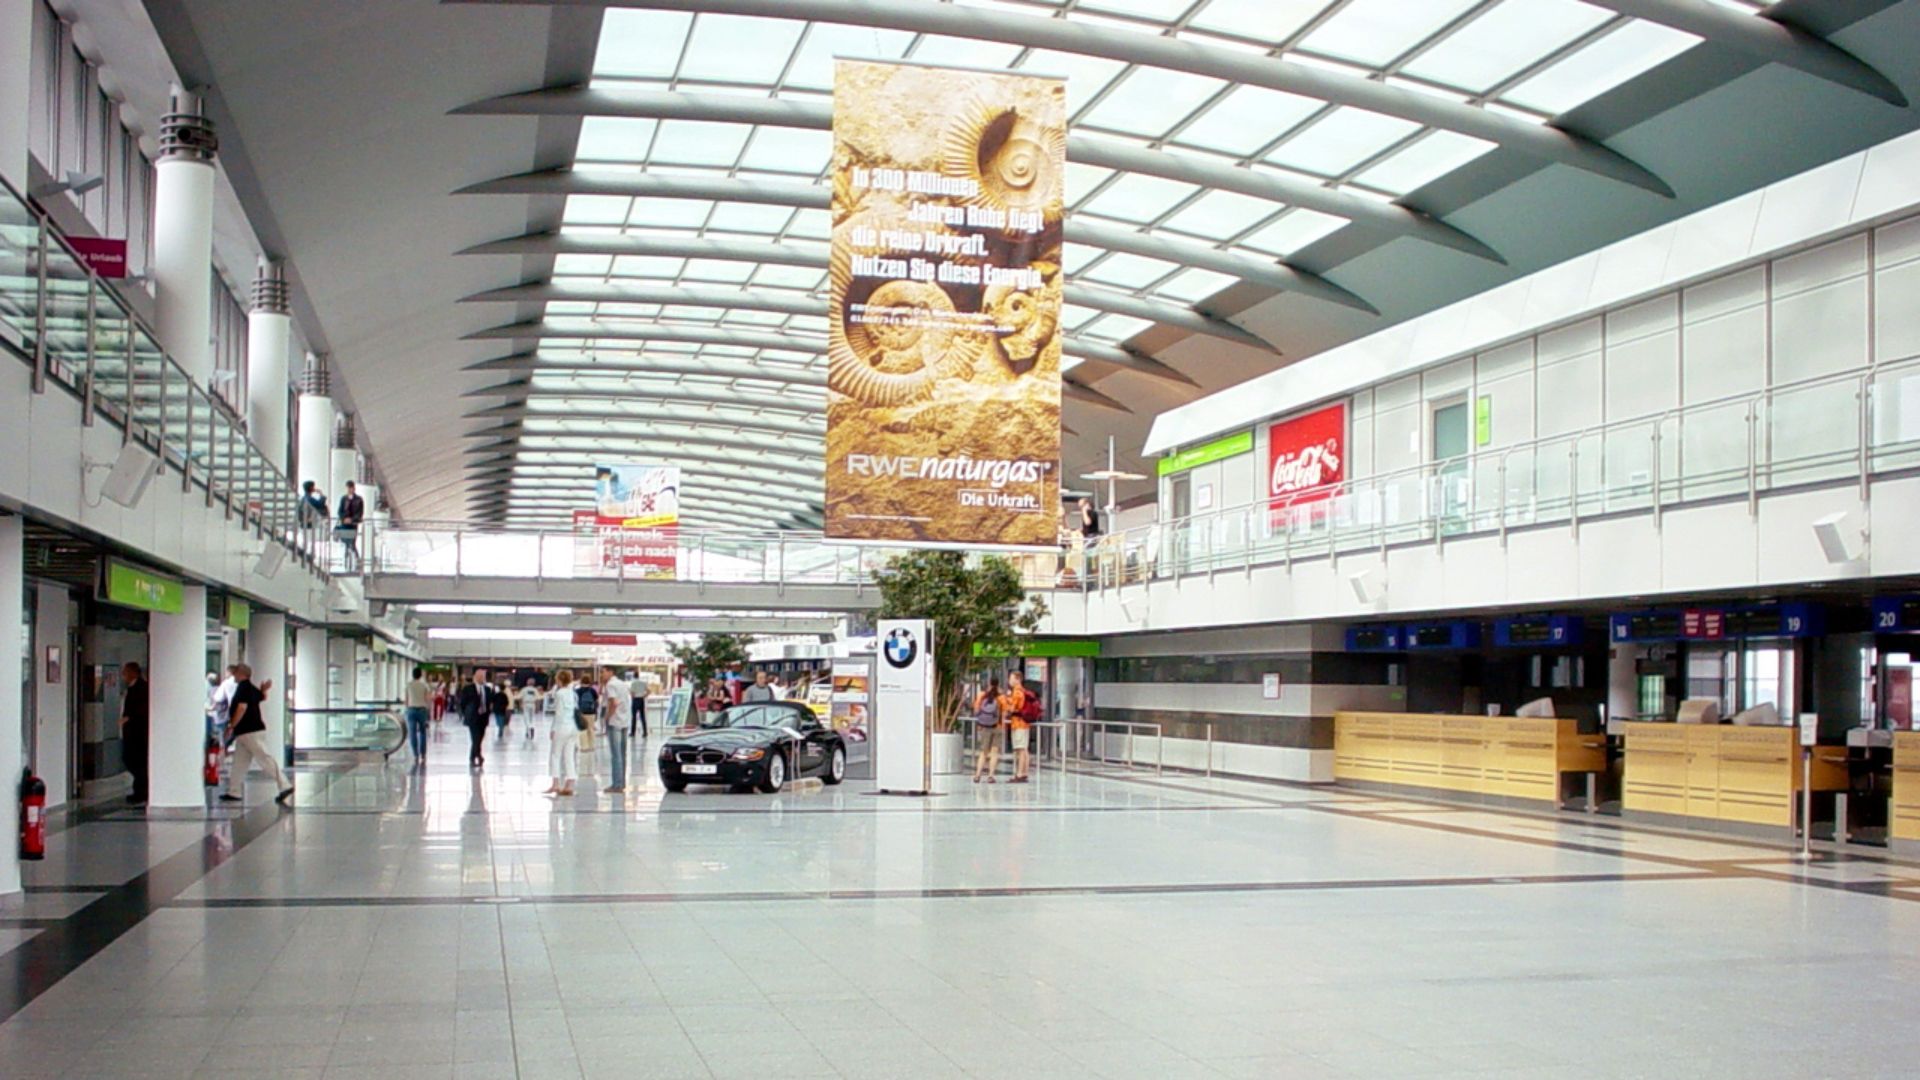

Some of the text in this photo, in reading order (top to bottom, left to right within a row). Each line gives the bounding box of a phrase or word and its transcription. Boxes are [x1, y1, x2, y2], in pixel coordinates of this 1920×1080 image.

[852, 166, 978, 197] In 300 Millionen
[907, 200, 1045, 234] Jahren Ruhe liegt
[852, 224, 989, 256] die reine Urkraft.
[851, 254, 1046, 290] Nutzen Sie diese Energie.
[960, 492, 1040, 508] Die Urkraft.
[1788, 617, 1801, 632] 19
[1879, 611, 1896, 627] 20
